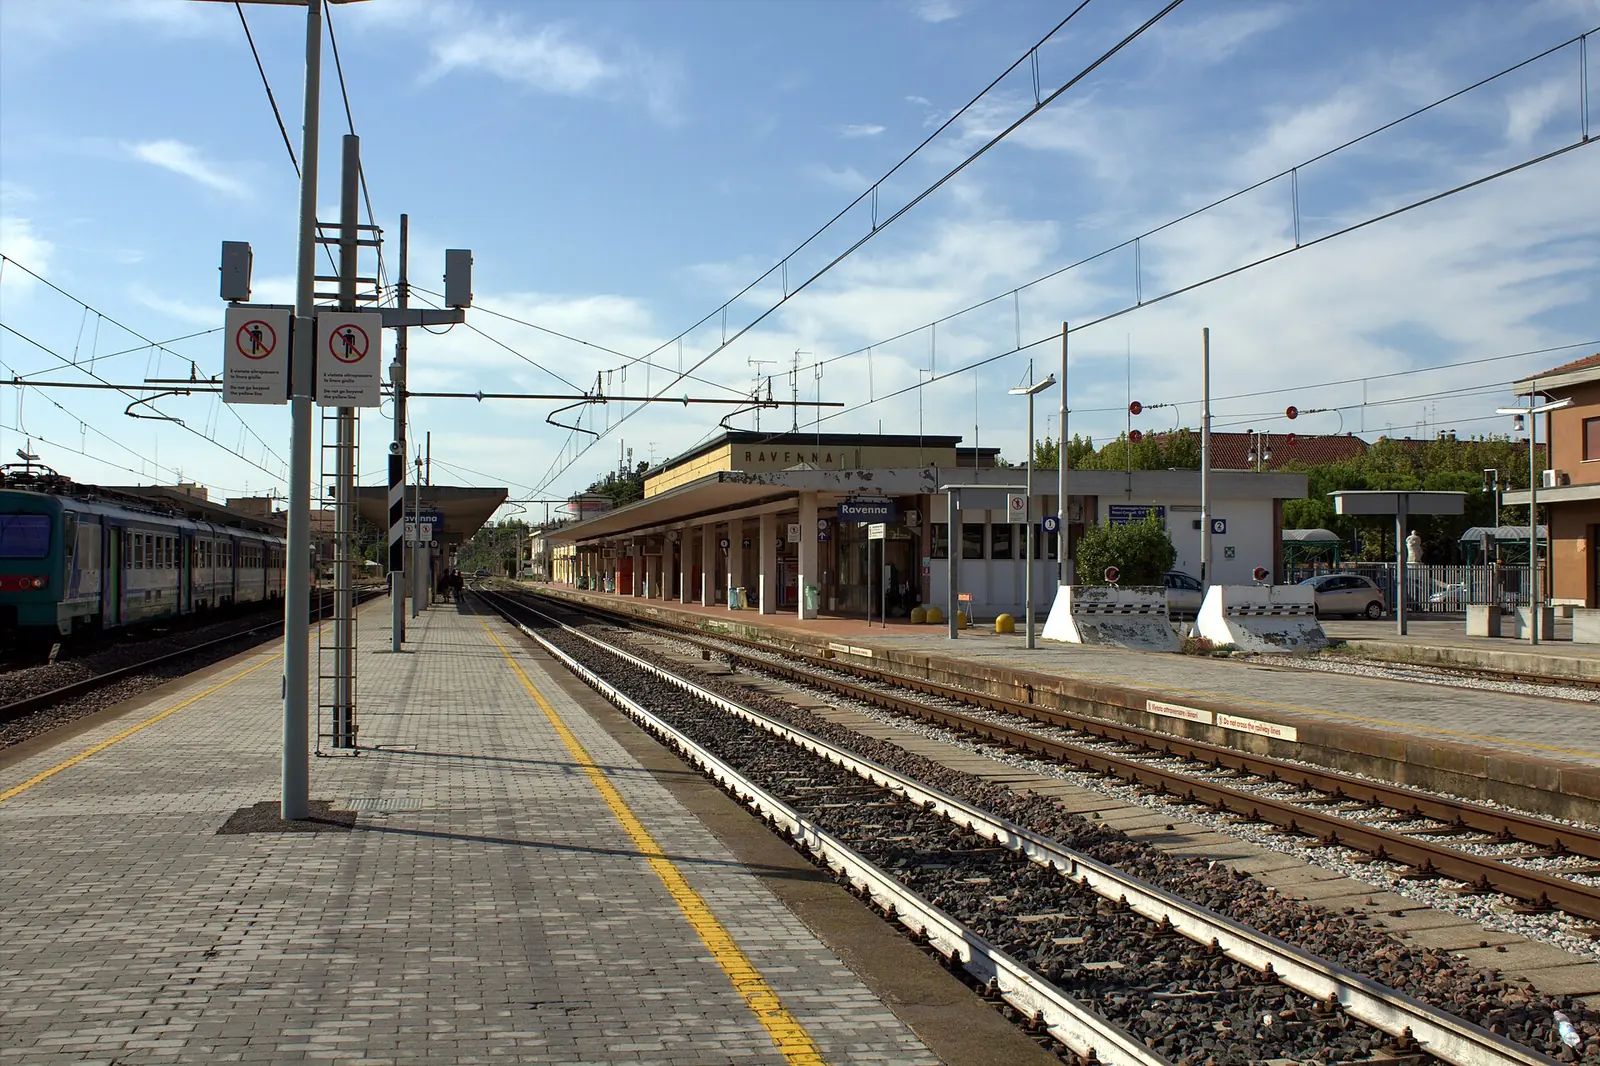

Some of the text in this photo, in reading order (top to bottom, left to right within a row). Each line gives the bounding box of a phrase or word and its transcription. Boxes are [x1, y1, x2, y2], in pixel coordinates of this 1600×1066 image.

[745, 452, 832, 462] RAVENNA
[842, 504, 888, 514] Ravenna
[1255, 724, 1270, 734] railway
[1271, 726, 1281, 735] lines
